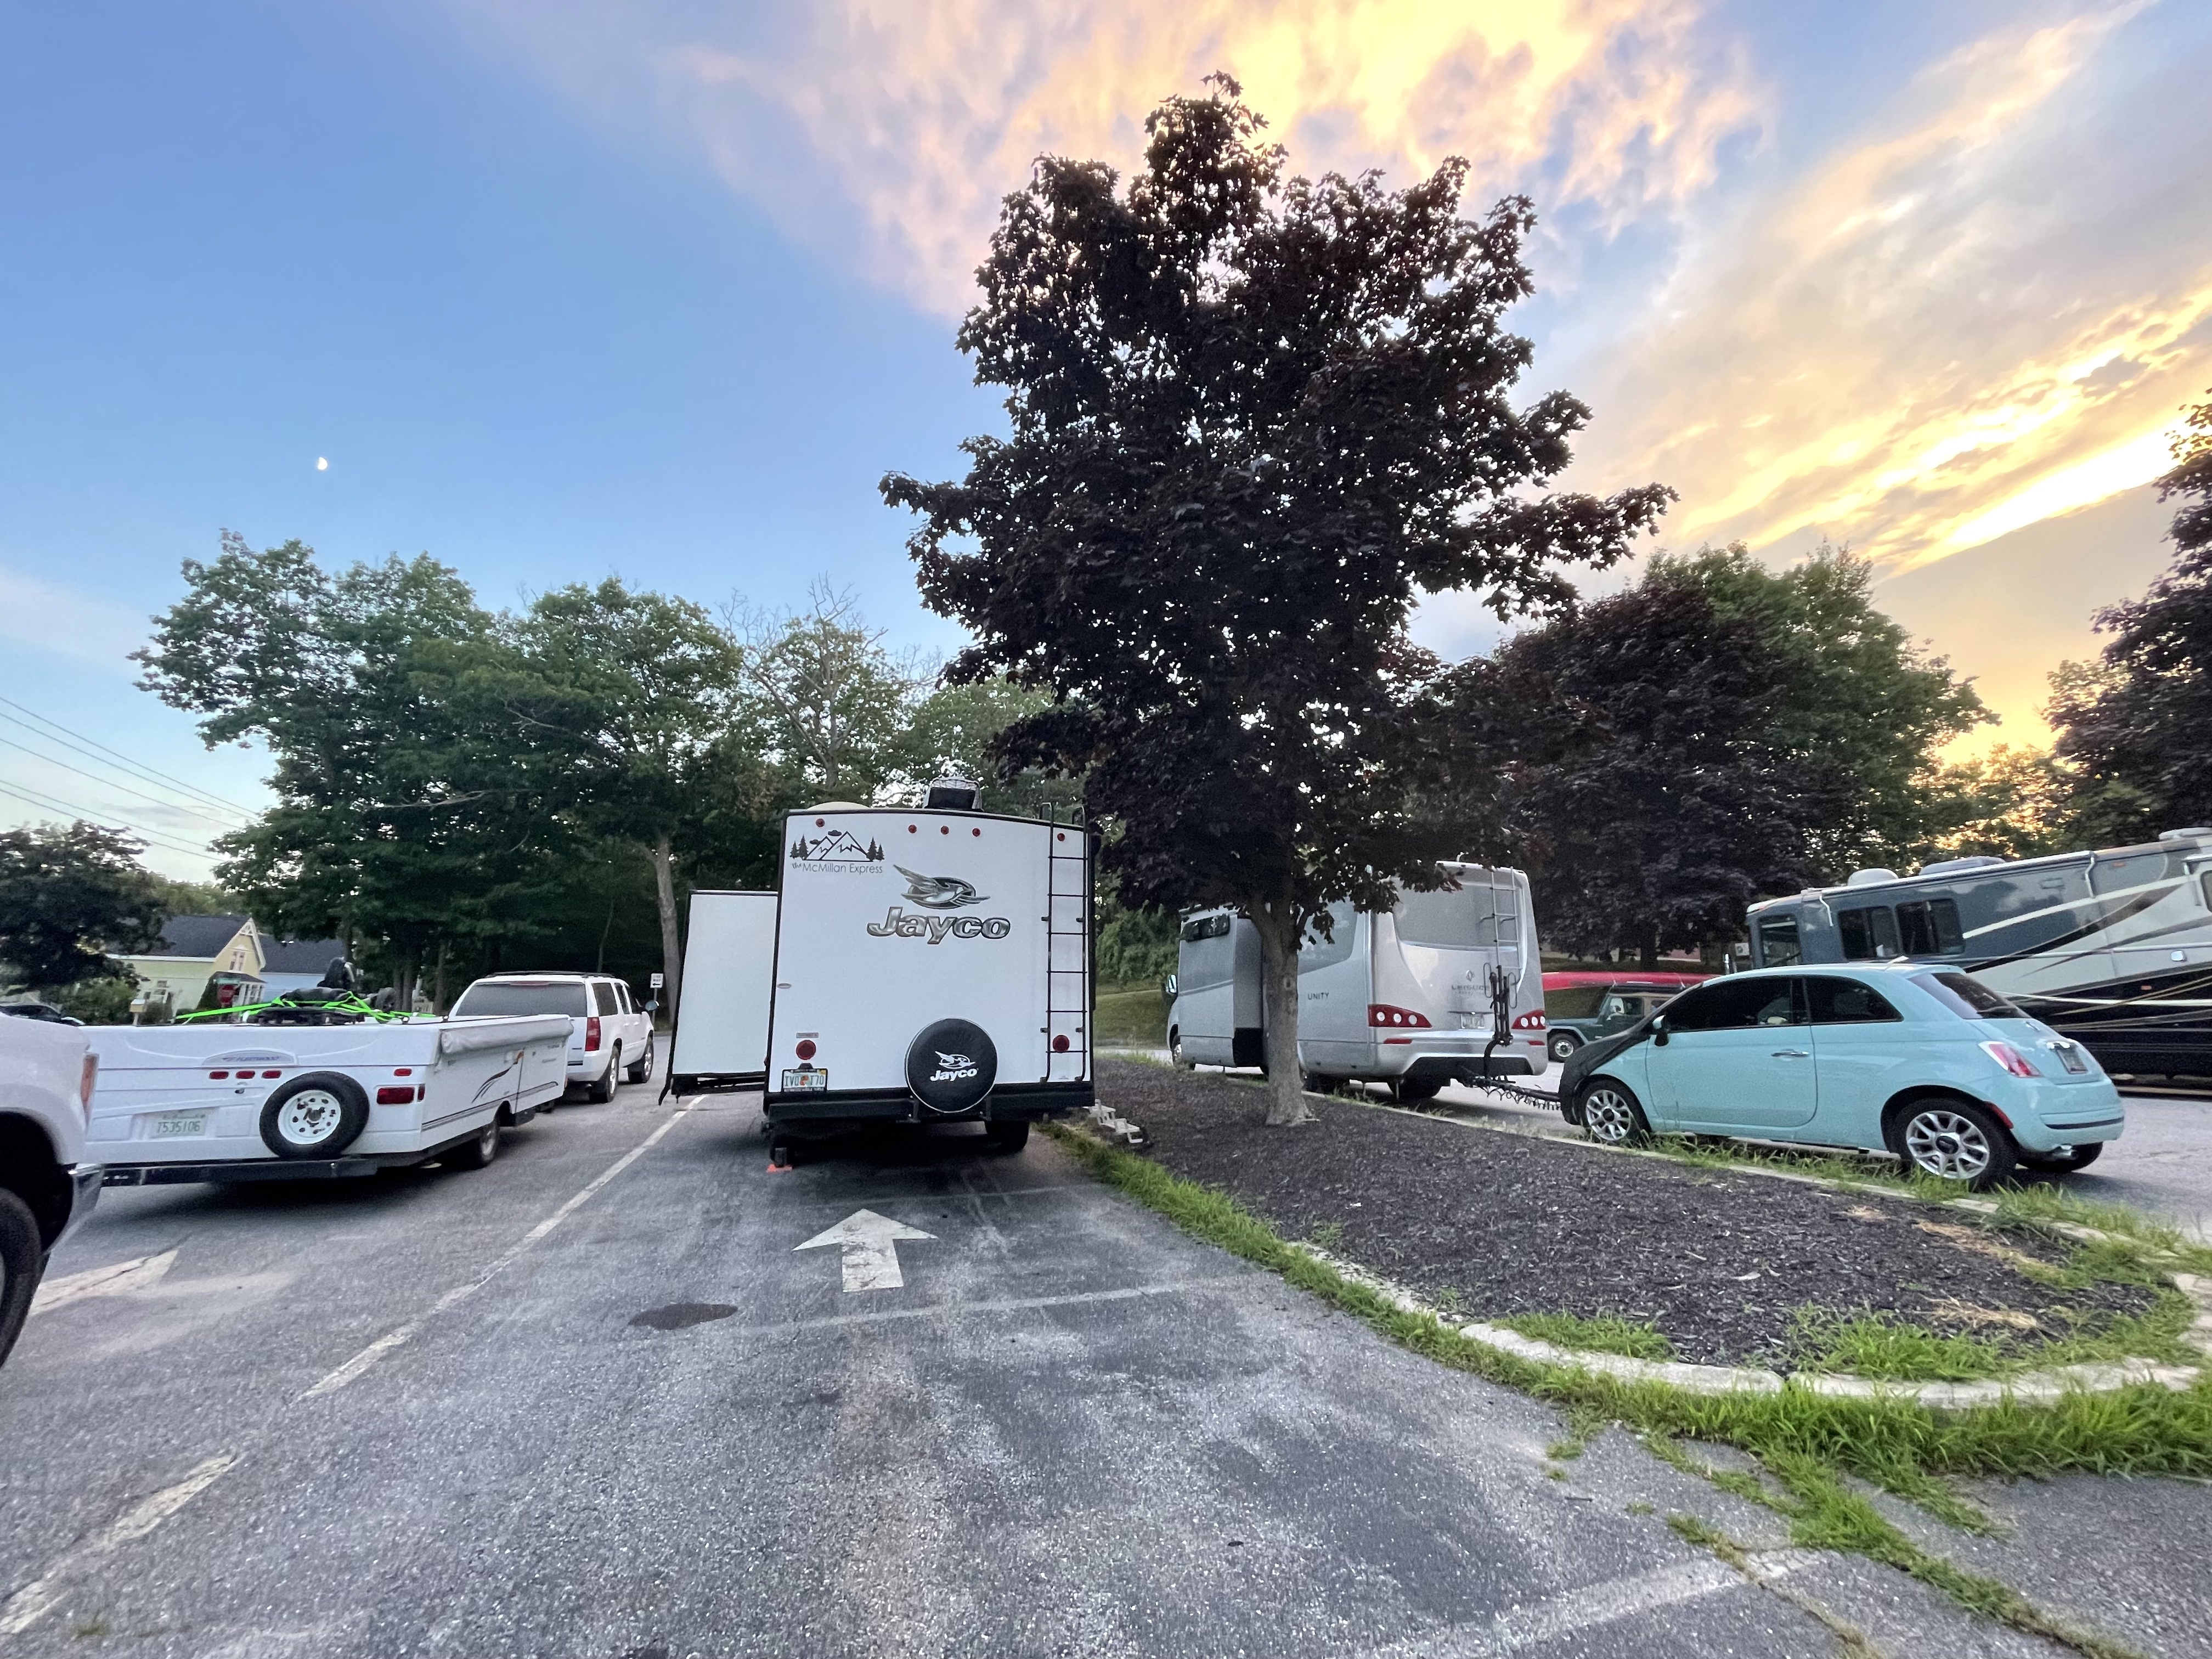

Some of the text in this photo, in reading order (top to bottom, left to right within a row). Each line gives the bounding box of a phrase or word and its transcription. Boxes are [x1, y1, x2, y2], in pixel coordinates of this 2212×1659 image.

[802, 863, 847, 873] McMillan
[849, 863, 883, 875] Express
[867, 906, 1011, 945] Jayco
[1307, 992, 1330, 1000] UNITY
[930, 1068, 977, 1082] Jayco
